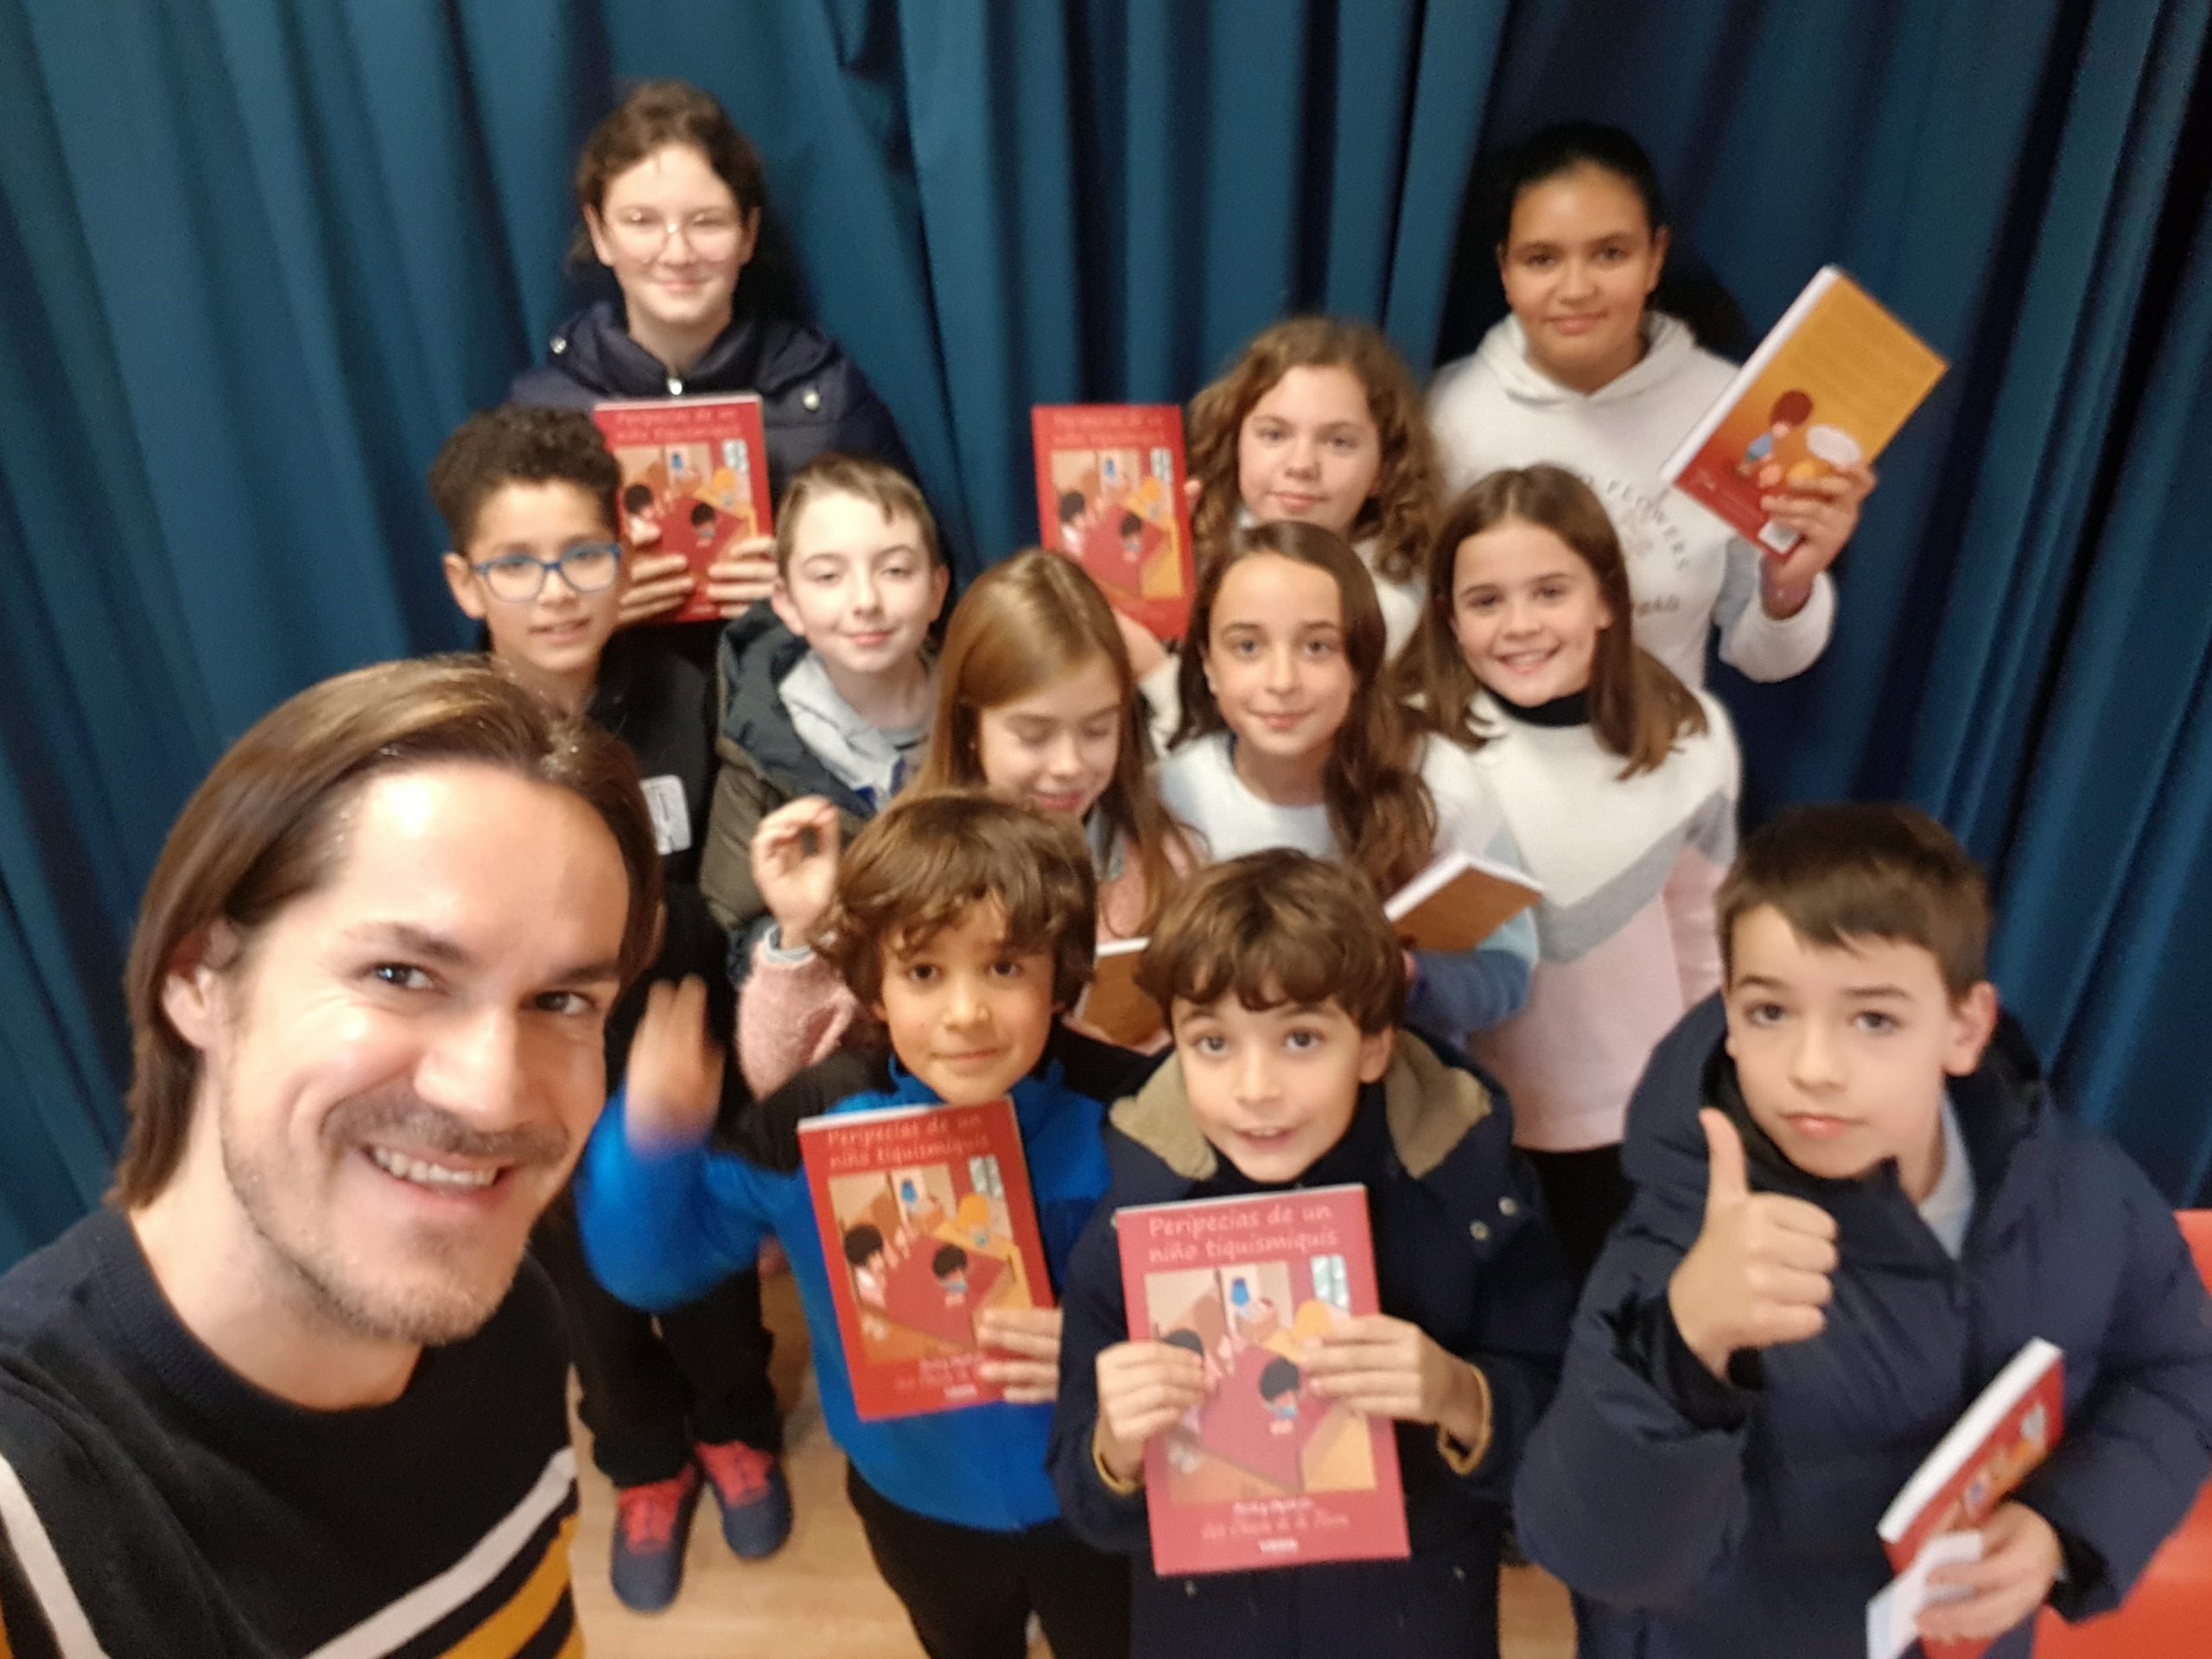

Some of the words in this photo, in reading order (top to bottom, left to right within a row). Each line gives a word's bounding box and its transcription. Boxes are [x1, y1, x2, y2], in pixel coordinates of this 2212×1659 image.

[1148, 1208, 1260, 1239] Peripecias
[1266, 1204, 1294, 1226] de
[1302, 1205, 1333, 1221] un
[1148, 1242, 1198, 1262] niño
[1205, 1227, 1338, 1261] tiquismiquis
